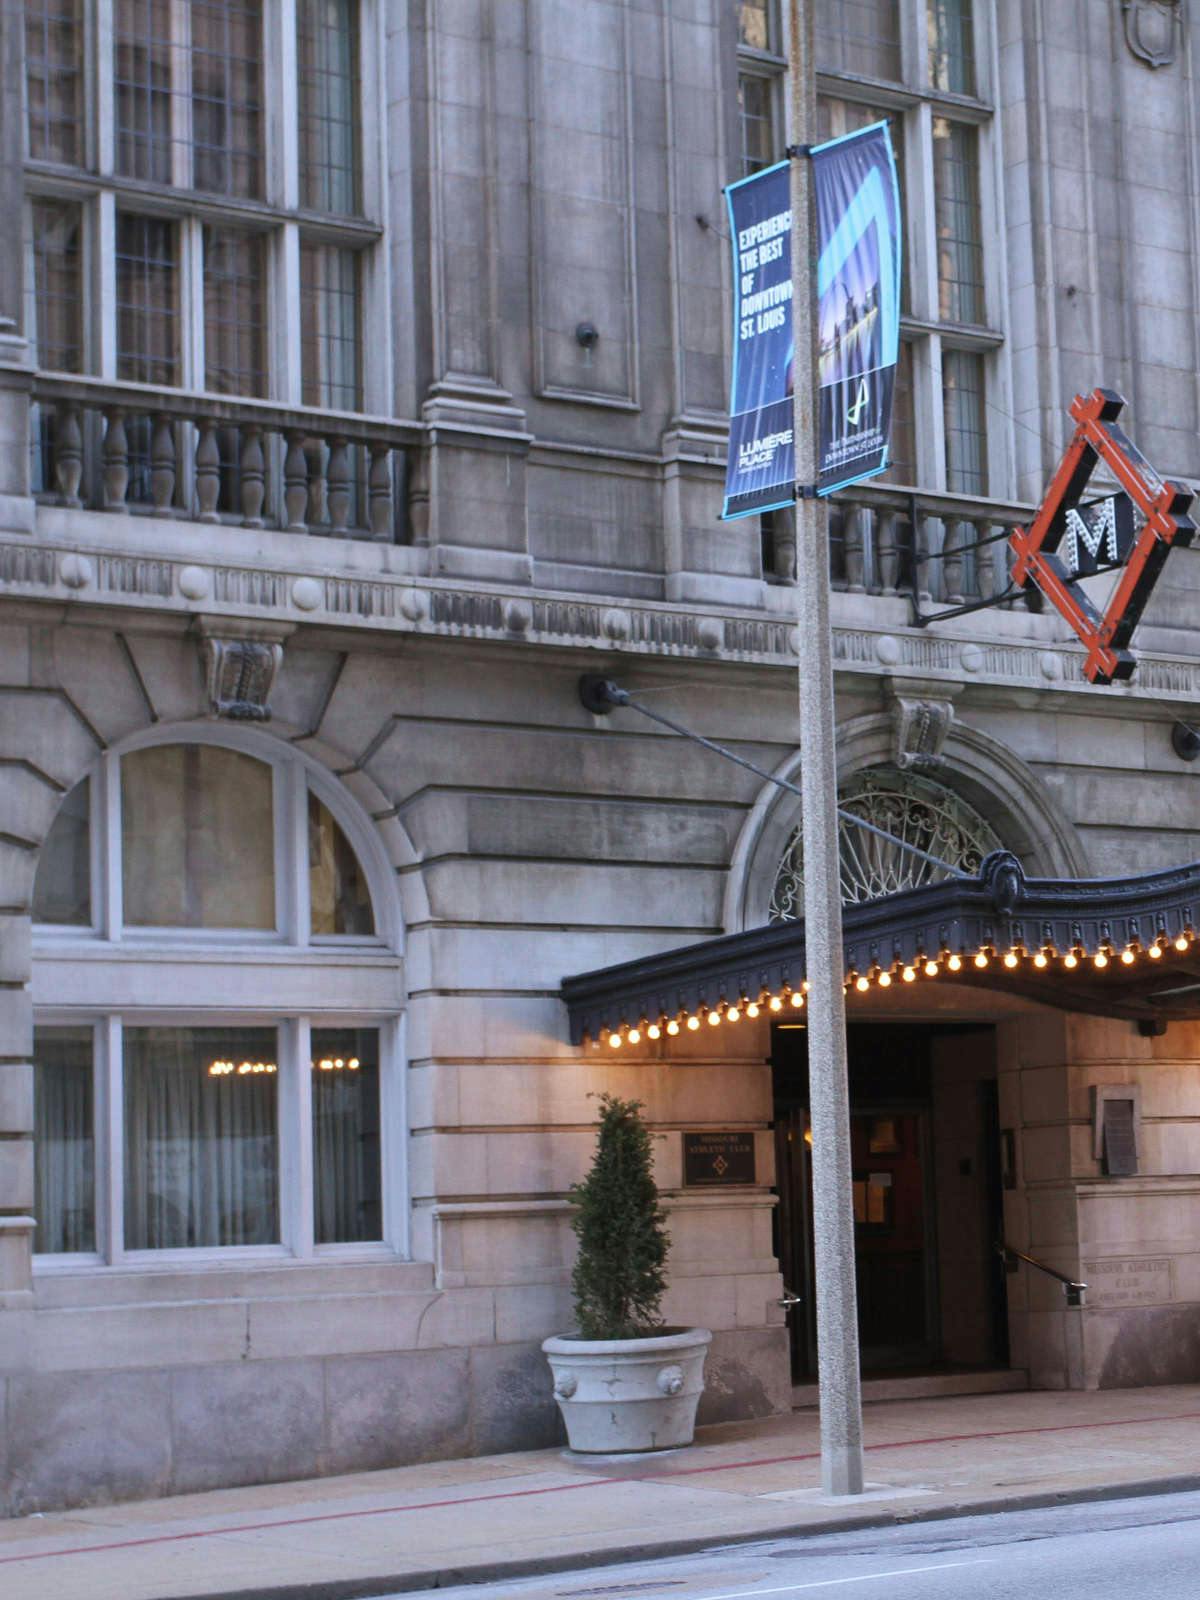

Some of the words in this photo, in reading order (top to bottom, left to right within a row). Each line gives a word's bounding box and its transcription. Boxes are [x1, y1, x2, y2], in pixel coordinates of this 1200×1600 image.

[739, 209, 793, 252] EXPERIENC
[740, 248, 759, 273] THE
[759, 237, 784, 265] BEST
[741, 273, 754, 295] OF
[741, 279, 793, 318] DOWNTOWN
[740, 318, 755, 340] ST.
[757, 305, 785, 334] LOUIS
[738, 449, 773, 468] PLACE
[1065, 496, 1118, 572] M
